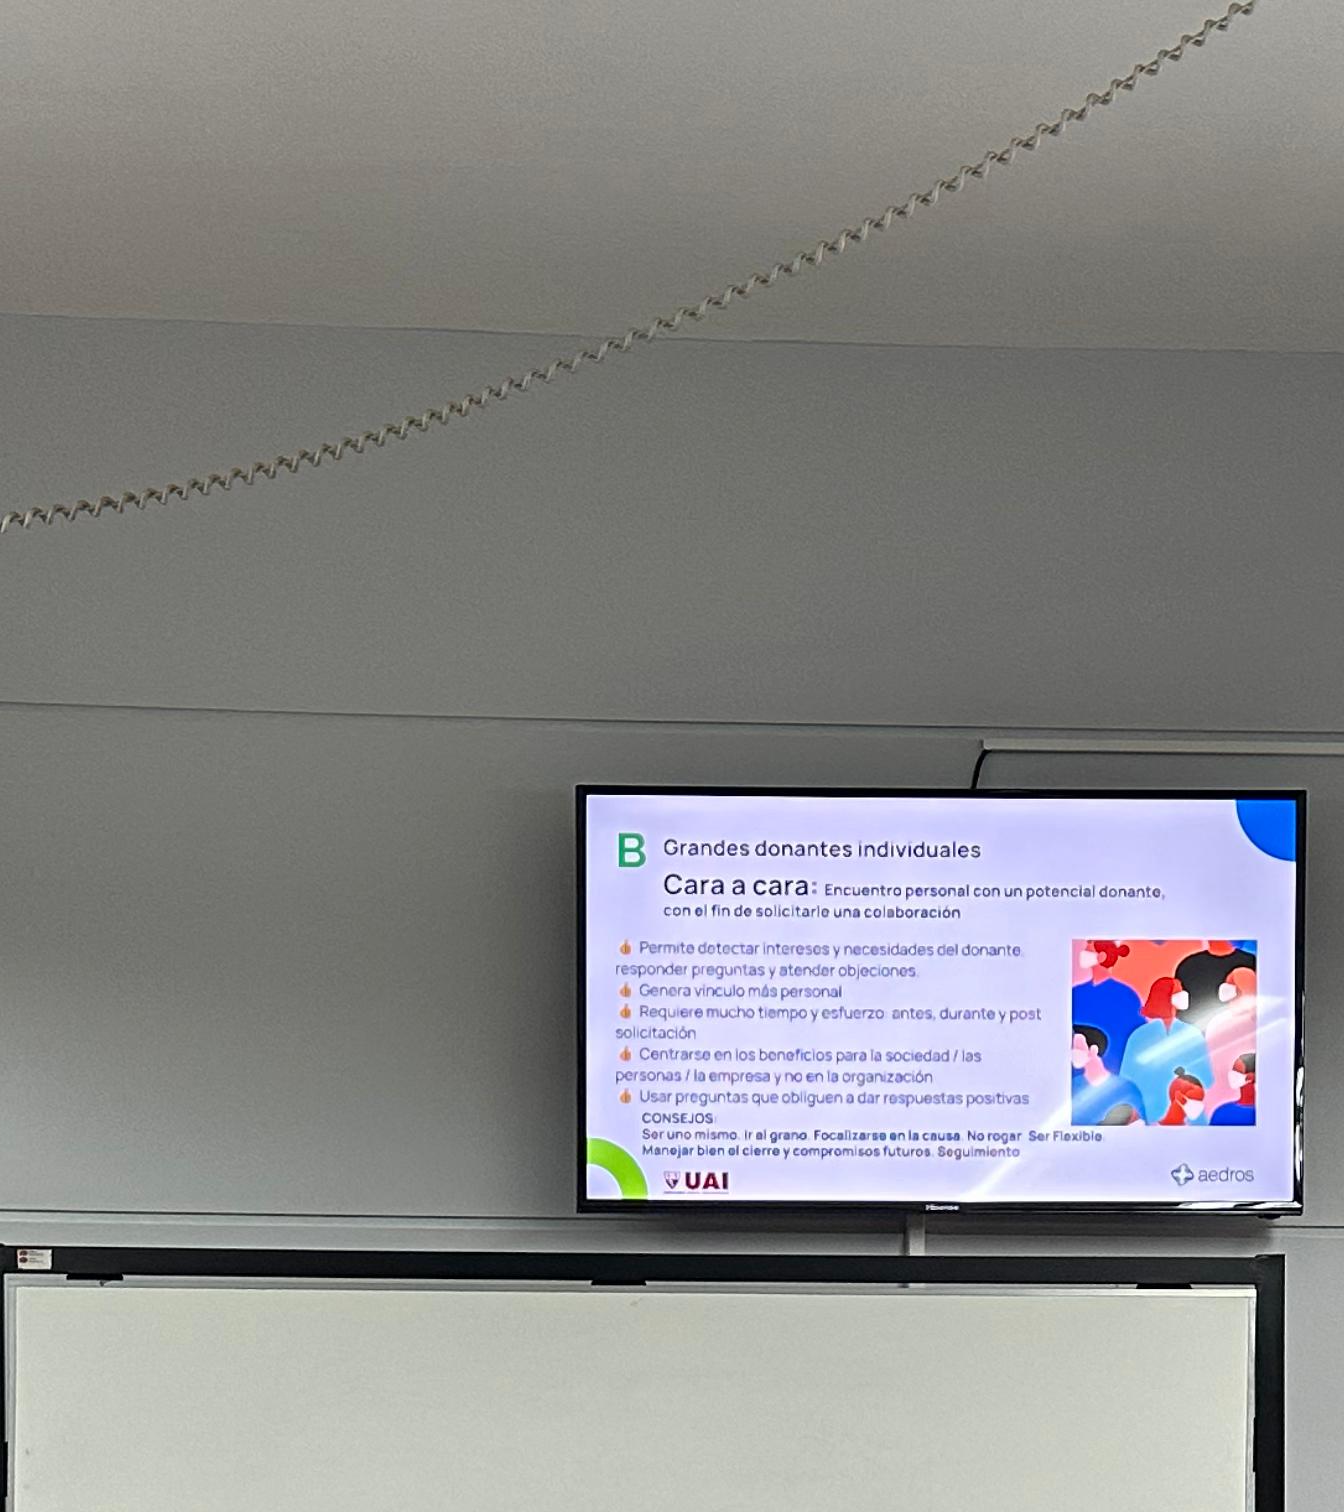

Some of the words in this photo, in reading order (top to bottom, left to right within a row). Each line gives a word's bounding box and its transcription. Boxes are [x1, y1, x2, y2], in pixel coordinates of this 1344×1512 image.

[618, 832, 646, 868] B
[663, 838, 750, 856] Grandes
[755, 840, 852, 857] donantes
[858, 841, 981, 858] individuales
[664, 873, 724, 895] Cara
[732, 878, 745, 896] a
[753, 878, 817, 896] cara:
[824, 883, 902, 897] Encuentro
[905, 884, 970, 901] personal
[973, 887, 1001, 898] con
[1004, 886, 1023, 898] un
[1026, 884, 1095, 901] potencial
[1099, 885, 1165, 900] donante,
[663, 905, 691, 917] con
[694, 904, 707, 917] el
[711, 904, 731, 917] fin
[734, 904, 752, 917] de
[755, 904, 830, 918] solicitarle
[833, 907, 861, 918] una
[864, 905, 961, 919] colaboración
[639, 941, 695, 955] Permite
[698, 942, 760, 955] detectar
[763, 942, 830, 956] intereses
[844, 943, 934, 957] necesidades
[936, 944, 958, 956] del
[616, 963, 688, 979] responder
[692, 964, 765, 980] preguntas
[779, 963, 836, 977] atender
[639, 983, 691, 997] Genera
[748, 984, 777, 998] más
[780, 985, 842, 1001] personal
[640, 1005, 703, 1022] Requiere
[706, 1005, 755, 1019] mucho
[758, 1006, 807, 1023] tiempo
[939, 1007, 996, 1020] durante
[1010, 1008, 1041, 1024] post
[615, 1026, 696, 1040] solicitación
[639, 1047, 711, 1061] Centrarse
[714, 1050, 732, 1061] en
[735, 1048, 756, 1062] los
[759, 1048, 833, 1062] beneficios
[836, 1051, 867, 1065] para
[870, 1049, 882, 1063] la
[885, 1049, 950, 1063] sociedad
[962, 1049, 982, 1063] las
[616, 1071, 682, 1085] personas
[694, 1069, 706, 1082] la
[709, 1071, 770, 1086] empresa
[773, 1072, 783, 1087] y
[784, 1072, 802, 1083] no
[805, 1072, 824, 1083] en
[827, 1070, 839, 1083] la
[842, 1069, 933, 1087] organización
[640, 1089, 674, 1103] Usar
[675, 1091, 749, 1107] preguntas
[751, 1093, 779, 1107] que
[782, 1090, 843, 1108] obliguen
[857, 1091, 880, 1104] dar
[883, 1092, 963, 1108] respuestas
[966, 1092, 1029, 1109] positivas
[642, 1128, 665, 1140] Ser
[667, 1131, 692, 1140] uno
[756, 1129, 767, 1141] al
[813, 1129, 887, 1142] Focalizarse
[889, 1132, 906, 1142] en
[908, 1129, 920, 1142] la
[967, 1130, 985, 1142] No
[1028, 1130, 1050, 1142] Ser
[642, 1144, 695, 1159] Manejar
[697, 1144, 725, 1157] bien
[727, 1144, 739, 1157] el
[742, 1144, 781, 1157] cierre
[793, 1145, 881, 1160] compromisos
[937, 1145, 1021, 1161] Seguimiento
[685, 1171, 728, 1190] UAI
[1197, 1166, 1255, 1182] aedros
